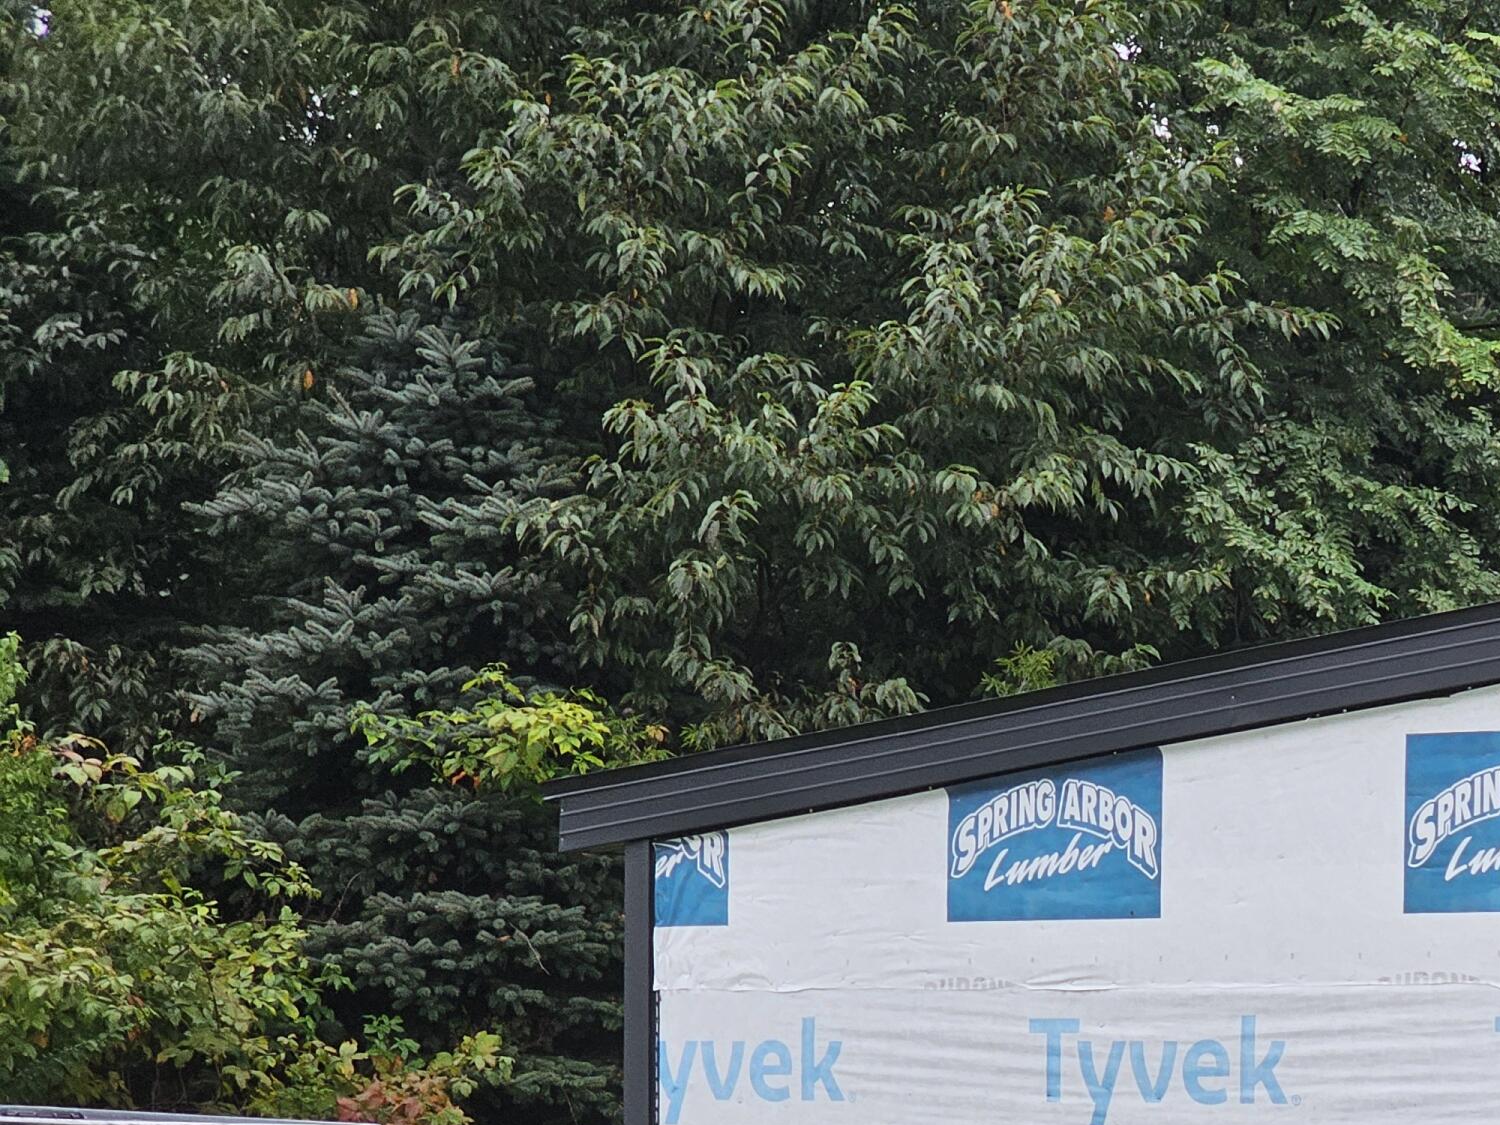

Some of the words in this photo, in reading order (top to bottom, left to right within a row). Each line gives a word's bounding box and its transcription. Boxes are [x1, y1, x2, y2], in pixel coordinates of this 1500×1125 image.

[951, 779, 1056, 878] SPRING
[1057, 779, 1158, 880] ARBOR
[984, 833, 1115, 892] Lumber
